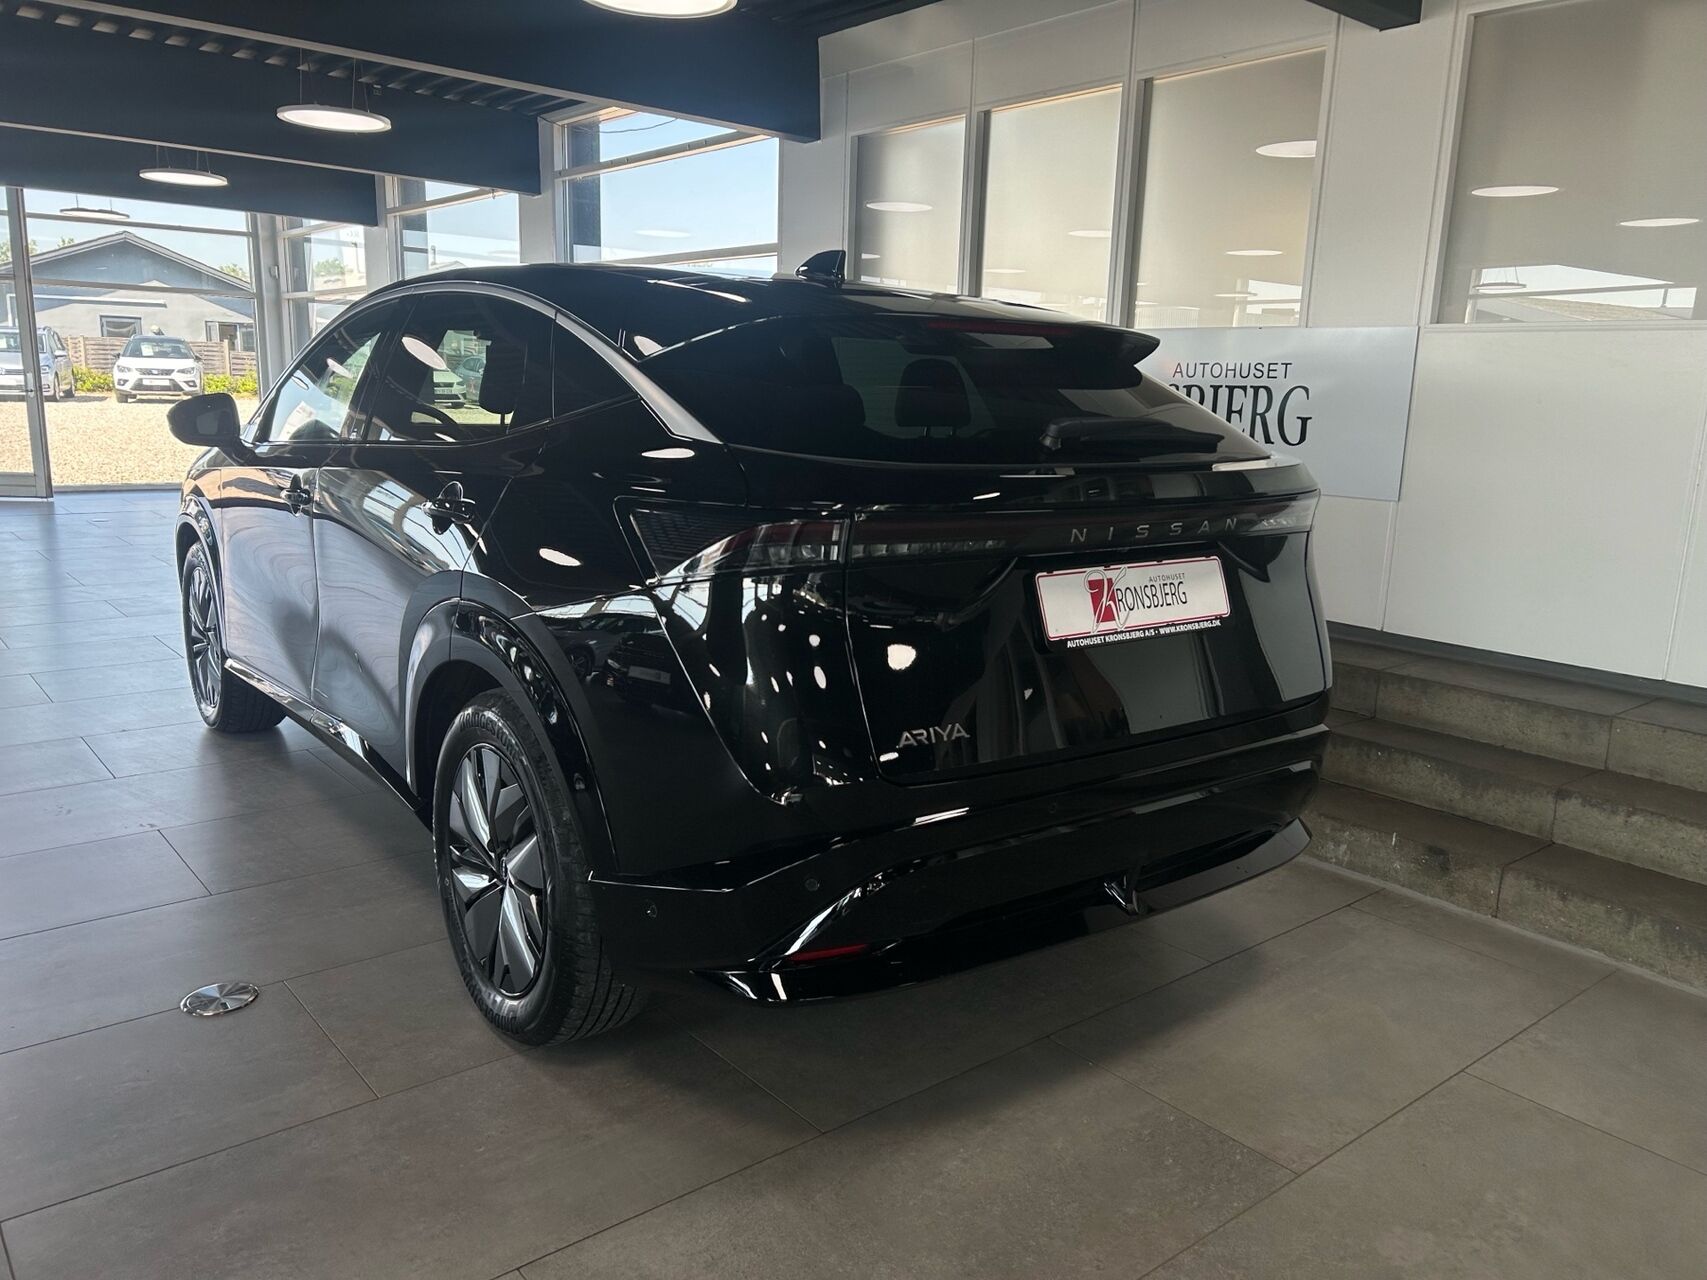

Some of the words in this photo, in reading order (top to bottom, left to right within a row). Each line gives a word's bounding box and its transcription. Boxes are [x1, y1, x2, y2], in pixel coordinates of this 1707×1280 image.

[1172, 362, 1293, 379] AUTOHUSET
[1070, 517, 1237, 543] NISSAN
[1149, 572, 1186, 583] AUTOHUSET
[1067, 635, 1105, 648] AUTOHUSET
[1105, 629, 1145, 644] KRONSBJERG
[1145, 628, 1155, 638] A/S
[1159, 619, 1222, 635] WWW.KRONSBJERG.DK
[898, 723, 971, 748] ARIYA
